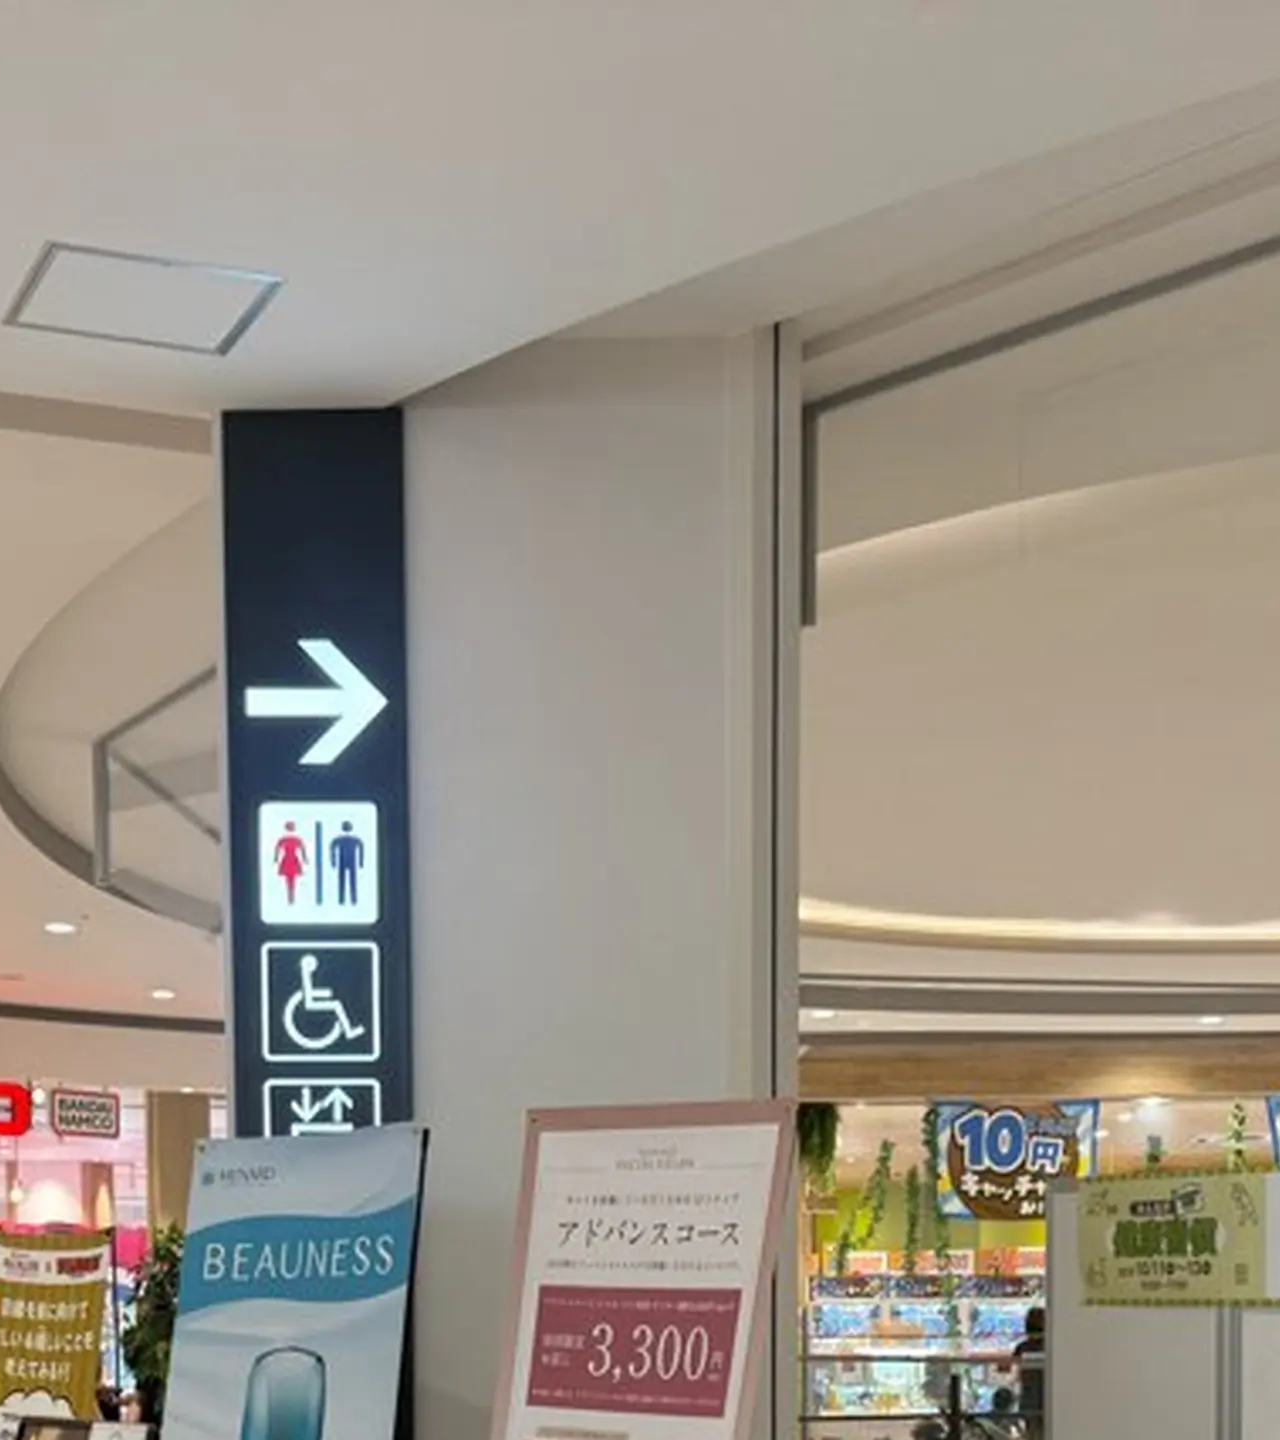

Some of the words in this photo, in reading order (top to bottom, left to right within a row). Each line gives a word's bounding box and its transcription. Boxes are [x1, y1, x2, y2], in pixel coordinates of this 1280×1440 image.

[58, 1112, 114, 1130] NAMCO
[955, 1109, 1063, 1174] 10円
[557, 1218, 741, 1248] アドバンスコース
[202, 1233, 396, 1282] BEAUNESS
